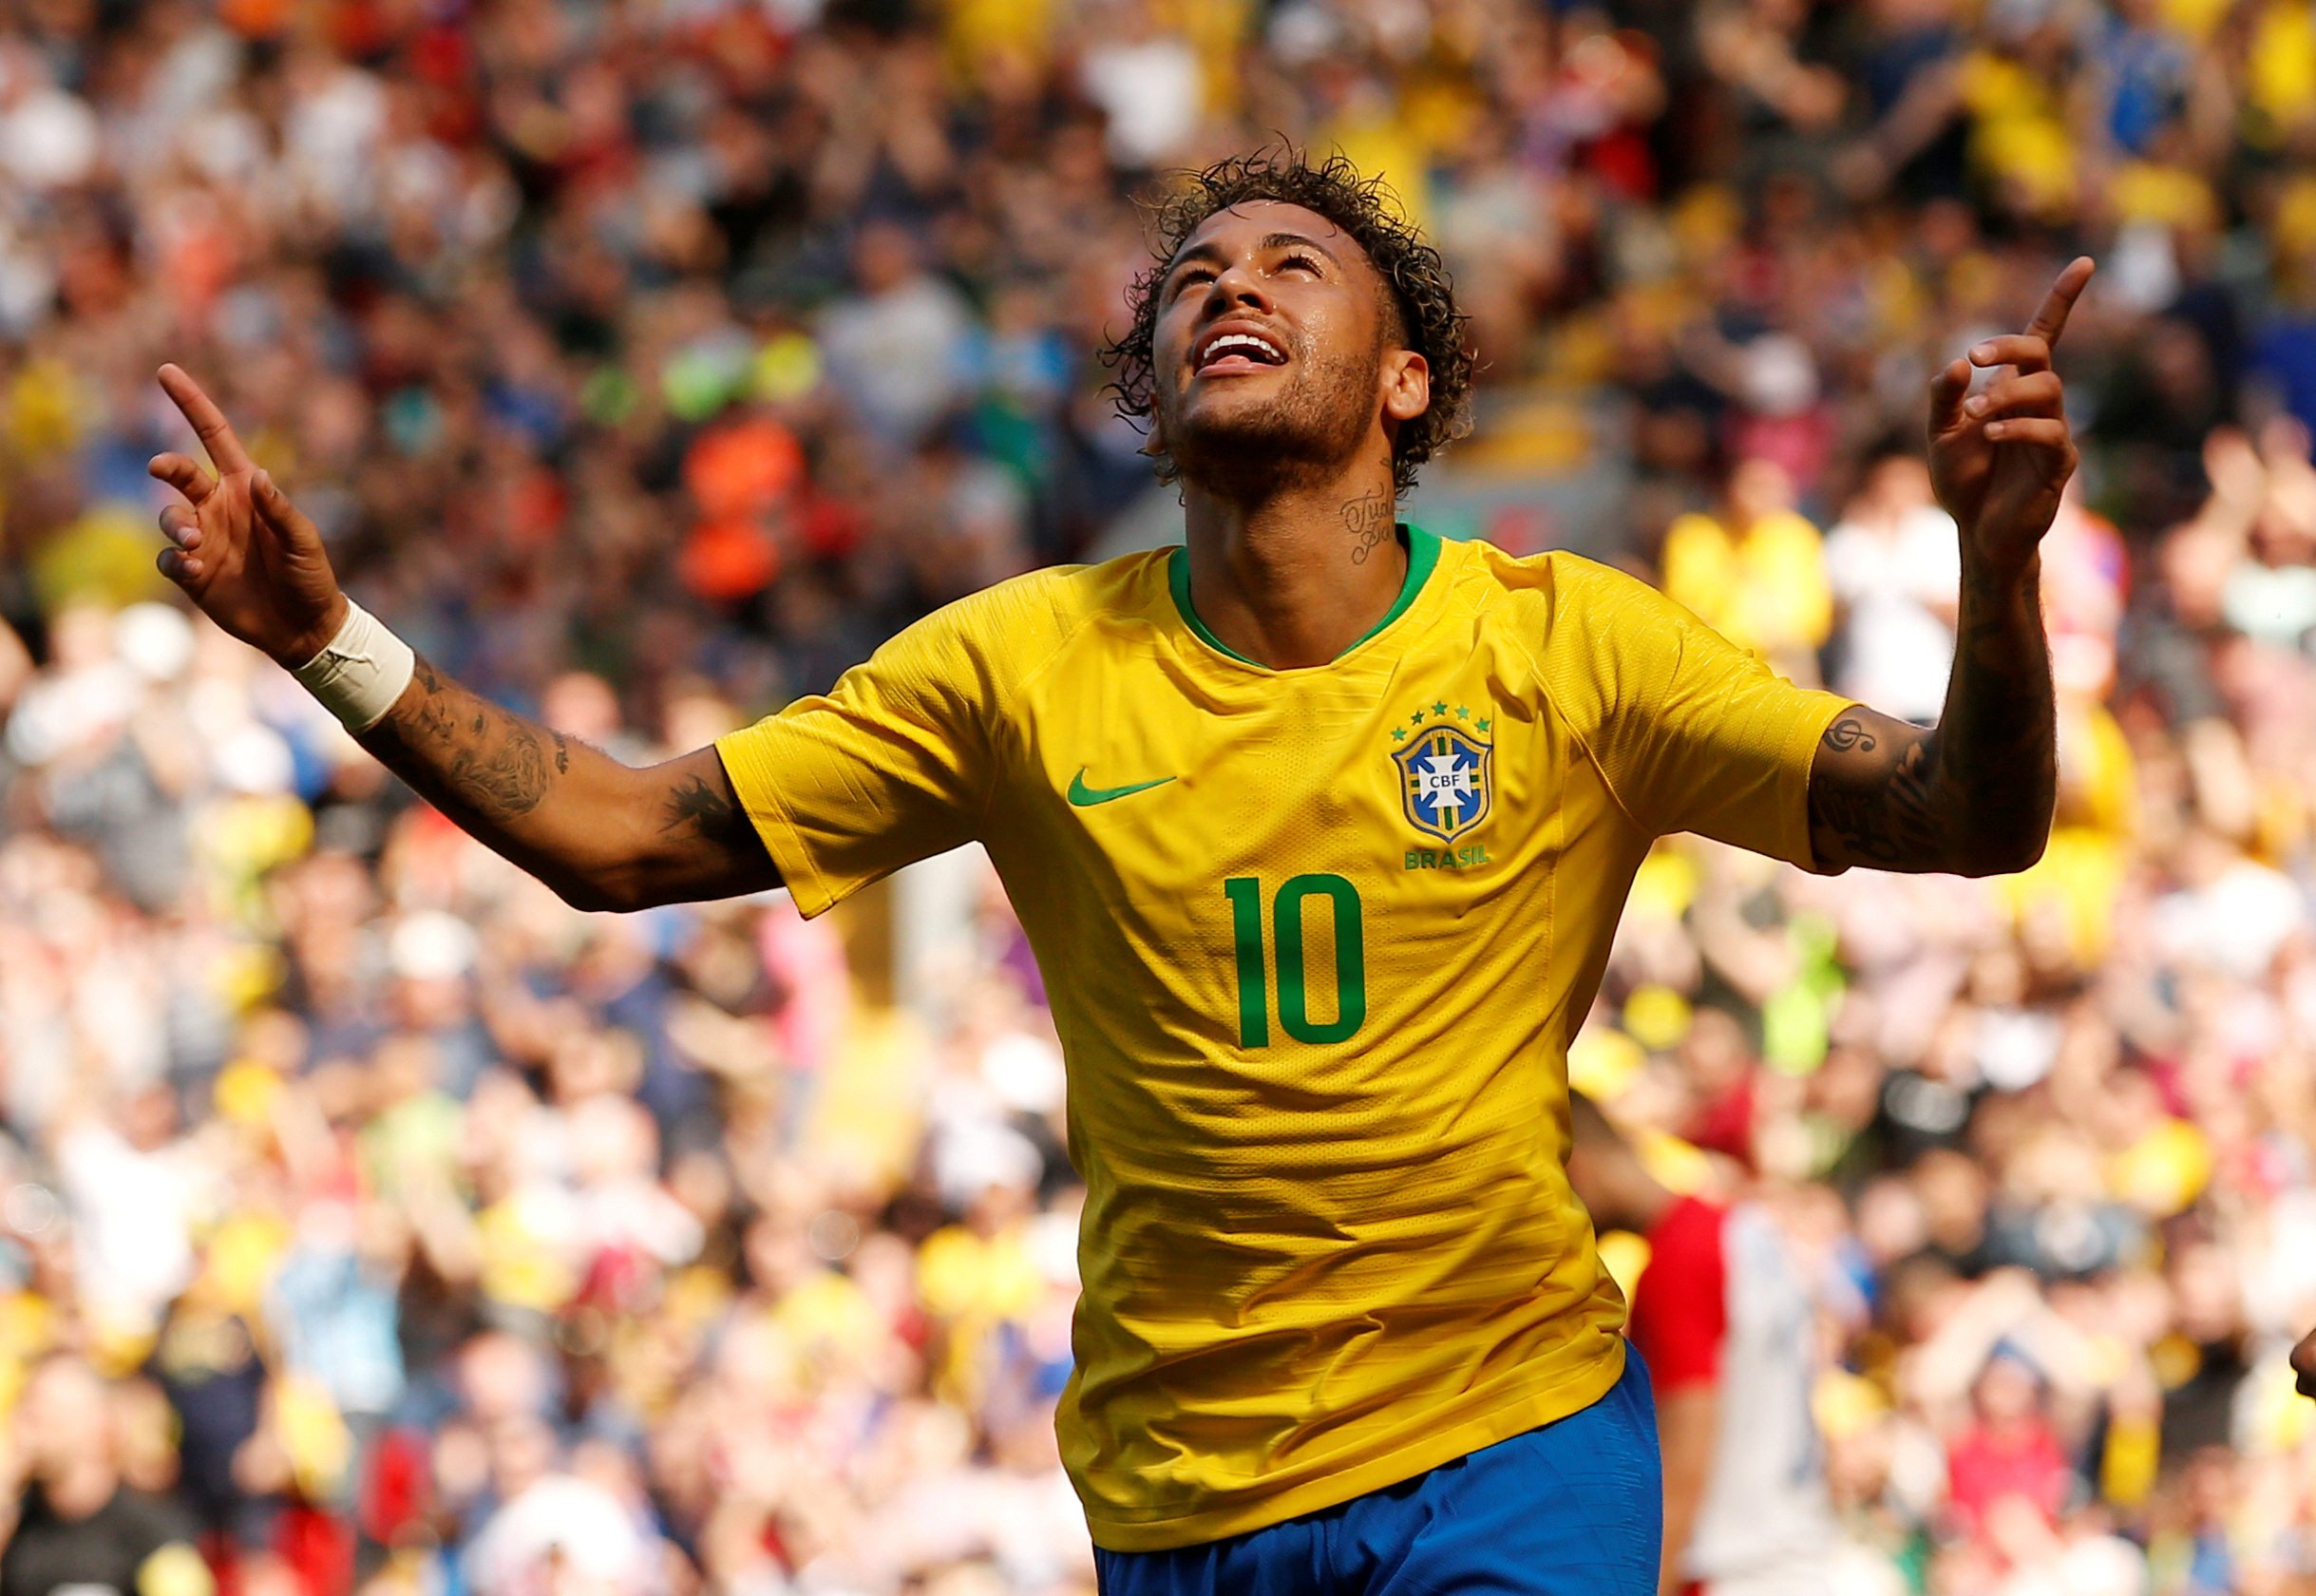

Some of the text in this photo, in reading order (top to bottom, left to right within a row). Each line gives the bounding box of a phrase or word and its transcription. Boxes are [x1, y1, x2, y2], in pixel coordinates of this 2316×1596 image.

[1339, 482, 1395, 533] Tud
[1430, 774, 1460, 788] CBF
[1405, 845, 1490, 870] BRASIL
[1224, 873, 1366, 1048] 10
